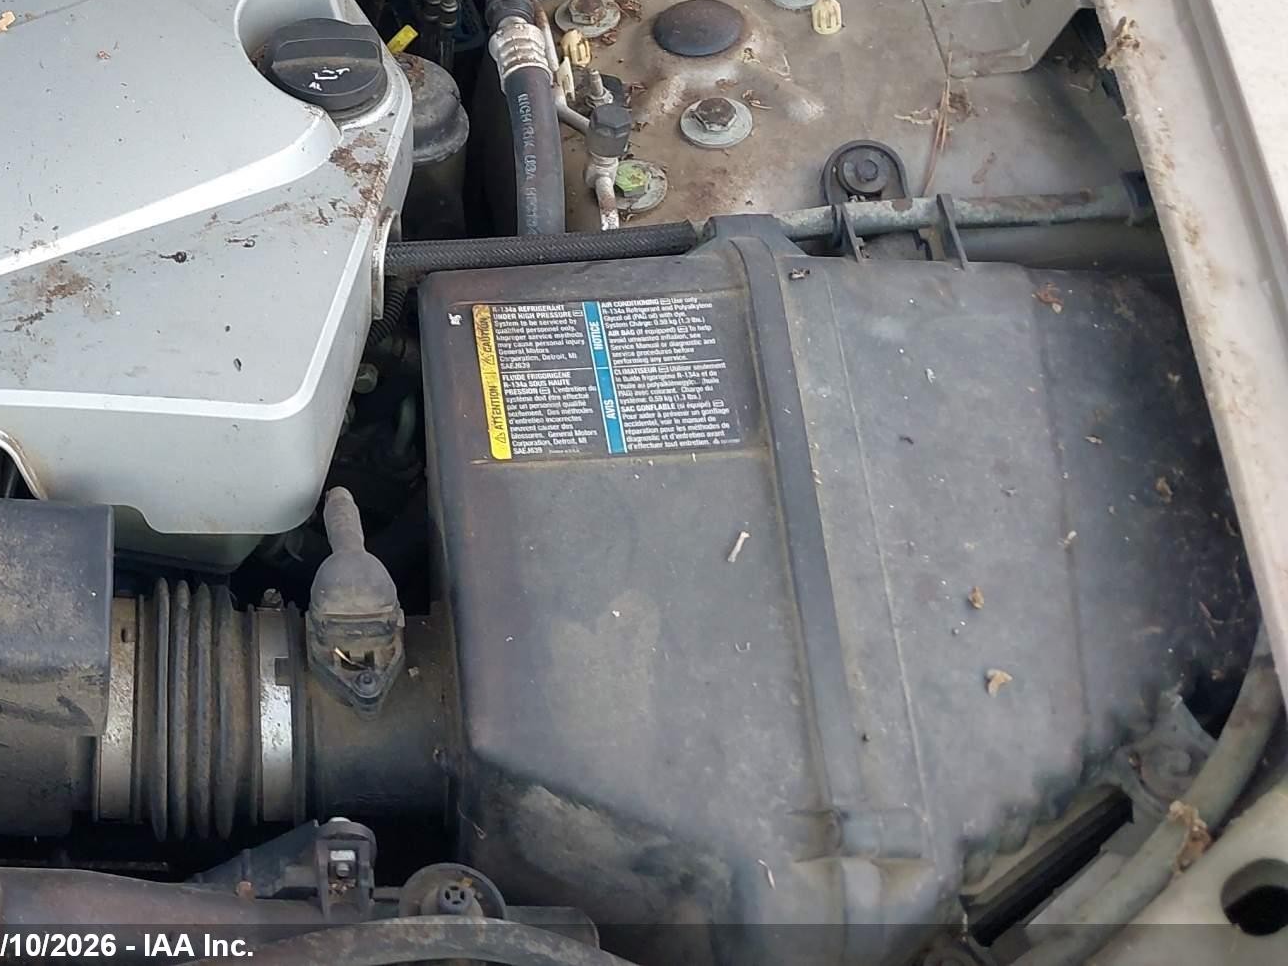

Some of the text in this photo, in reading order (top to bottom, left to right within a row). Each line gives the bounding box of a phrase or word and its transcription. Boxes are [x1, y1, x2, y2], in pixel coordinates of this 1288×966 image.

[480, 317, 492, 352] CAUTION
[589, 321, 604, 350] NOTICE
[490, 385, 505, 430] ATTENTION
[604, 399, 616, 419] AVIS
[637, 403, 675, 412] GONFLABLE
